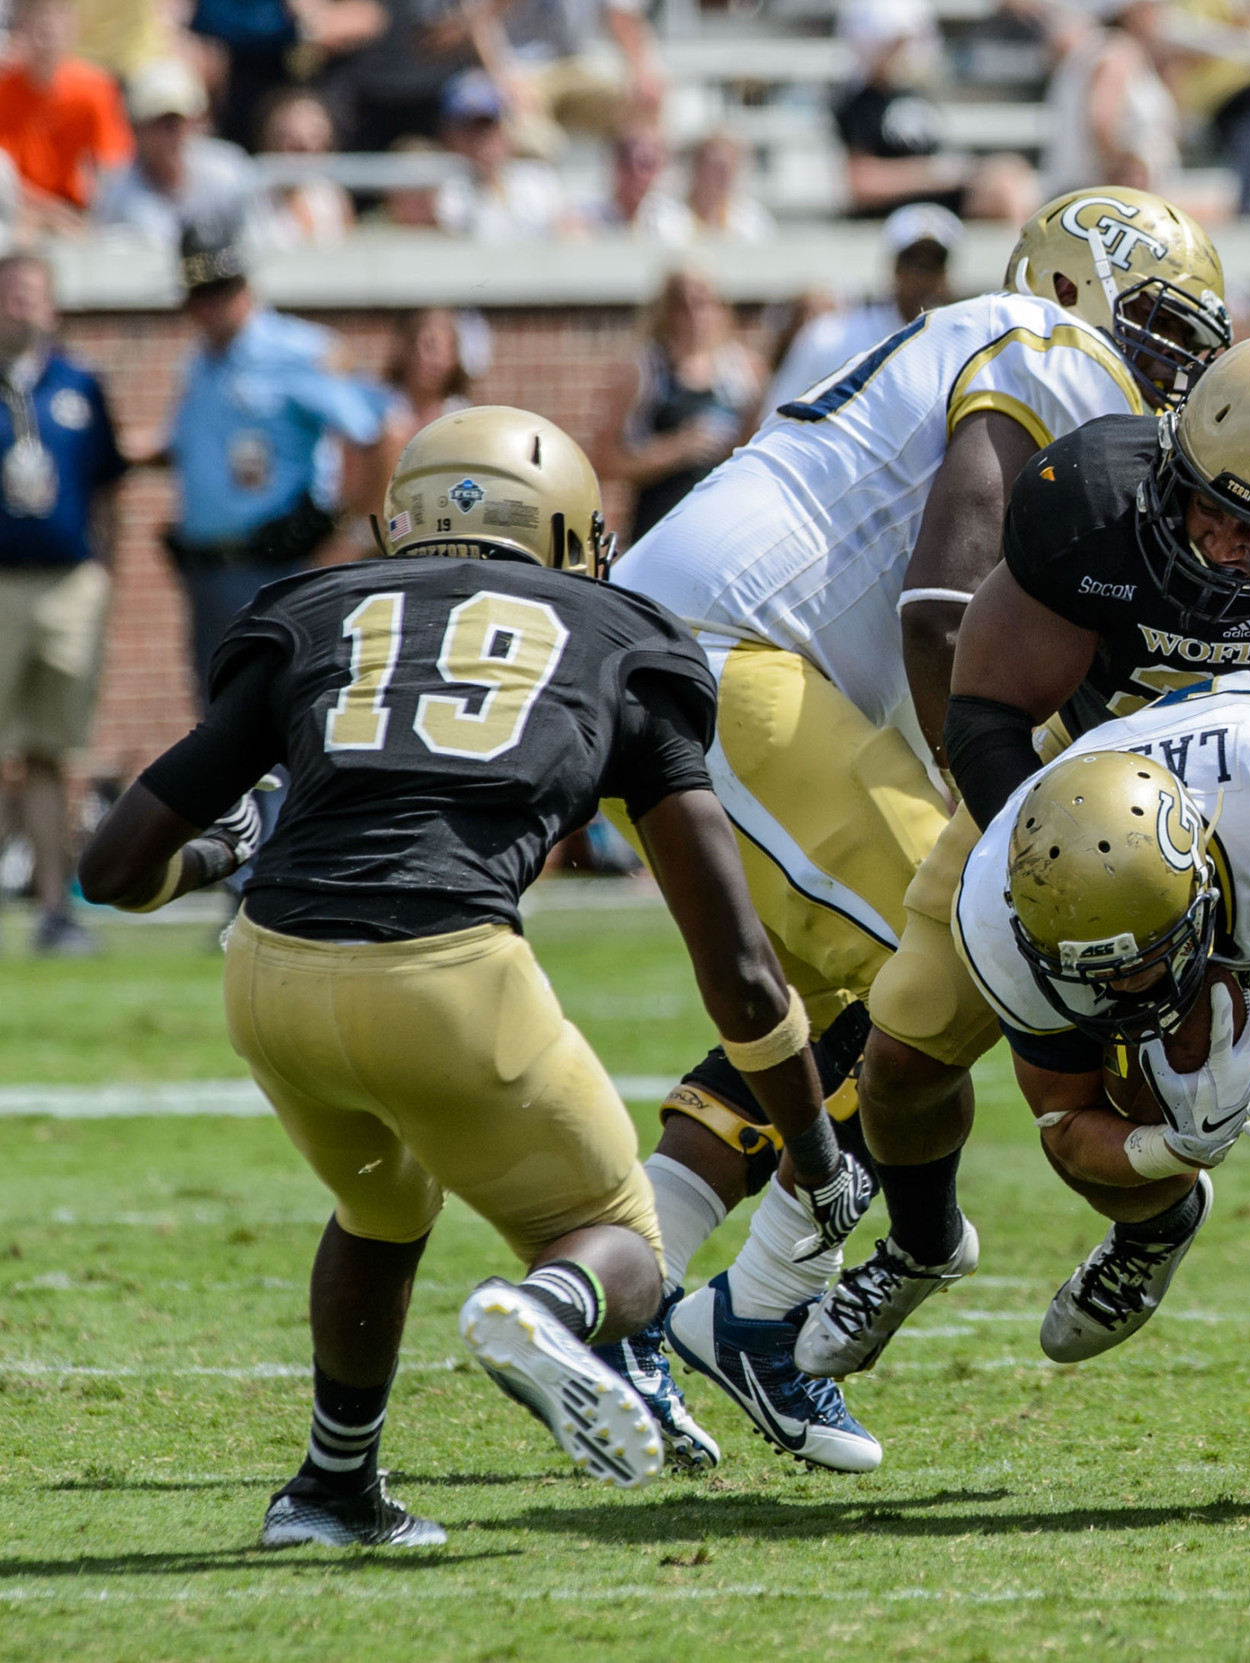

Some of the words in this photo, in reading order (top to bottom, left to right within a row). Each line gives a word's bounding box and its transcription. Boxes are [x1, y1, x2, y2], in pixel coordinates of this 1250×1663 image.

[1061, 196, 1168, 271] GT
[436, 517, 451, 533] 19
[323, 589, 571, 763] 19
[1127, 727, 1232, 790] LA
[1079, 942, 1115, 959] ACC
